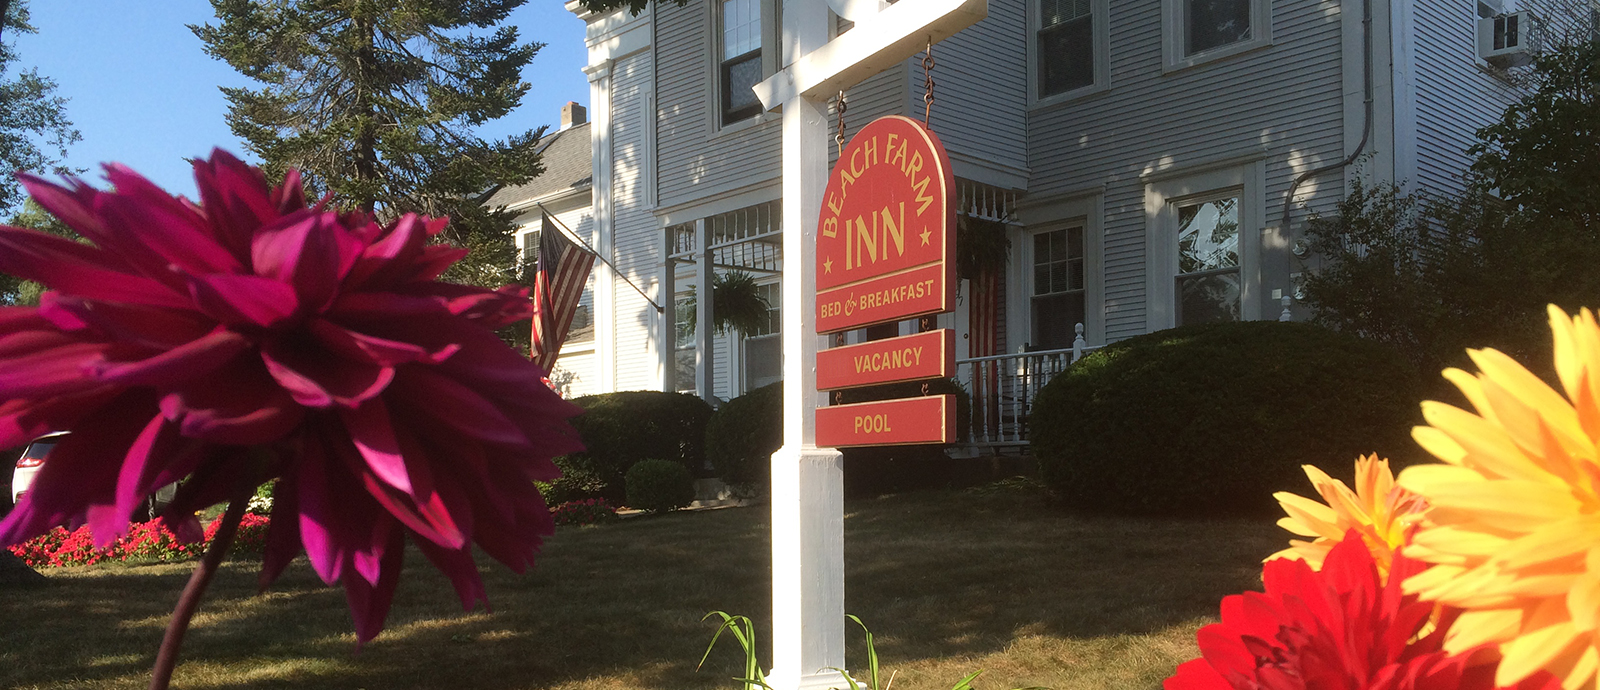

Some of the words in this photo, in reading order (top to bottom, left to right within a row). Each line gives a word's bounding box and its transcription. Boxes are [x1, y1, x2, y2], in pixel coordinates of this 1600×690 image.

[823, 135, 878, 239] BEACH
[884, 133, 934, 217] FARM
[846, 202, 905, 270] INN
[821, 302, 842, 318] BED
[844, 292, 857, 316] &
[860, 279, 934, 310] BREAKFAST
[854, 346, 923, 373] VACANCY
[854, 414, 891, 434] POOL
